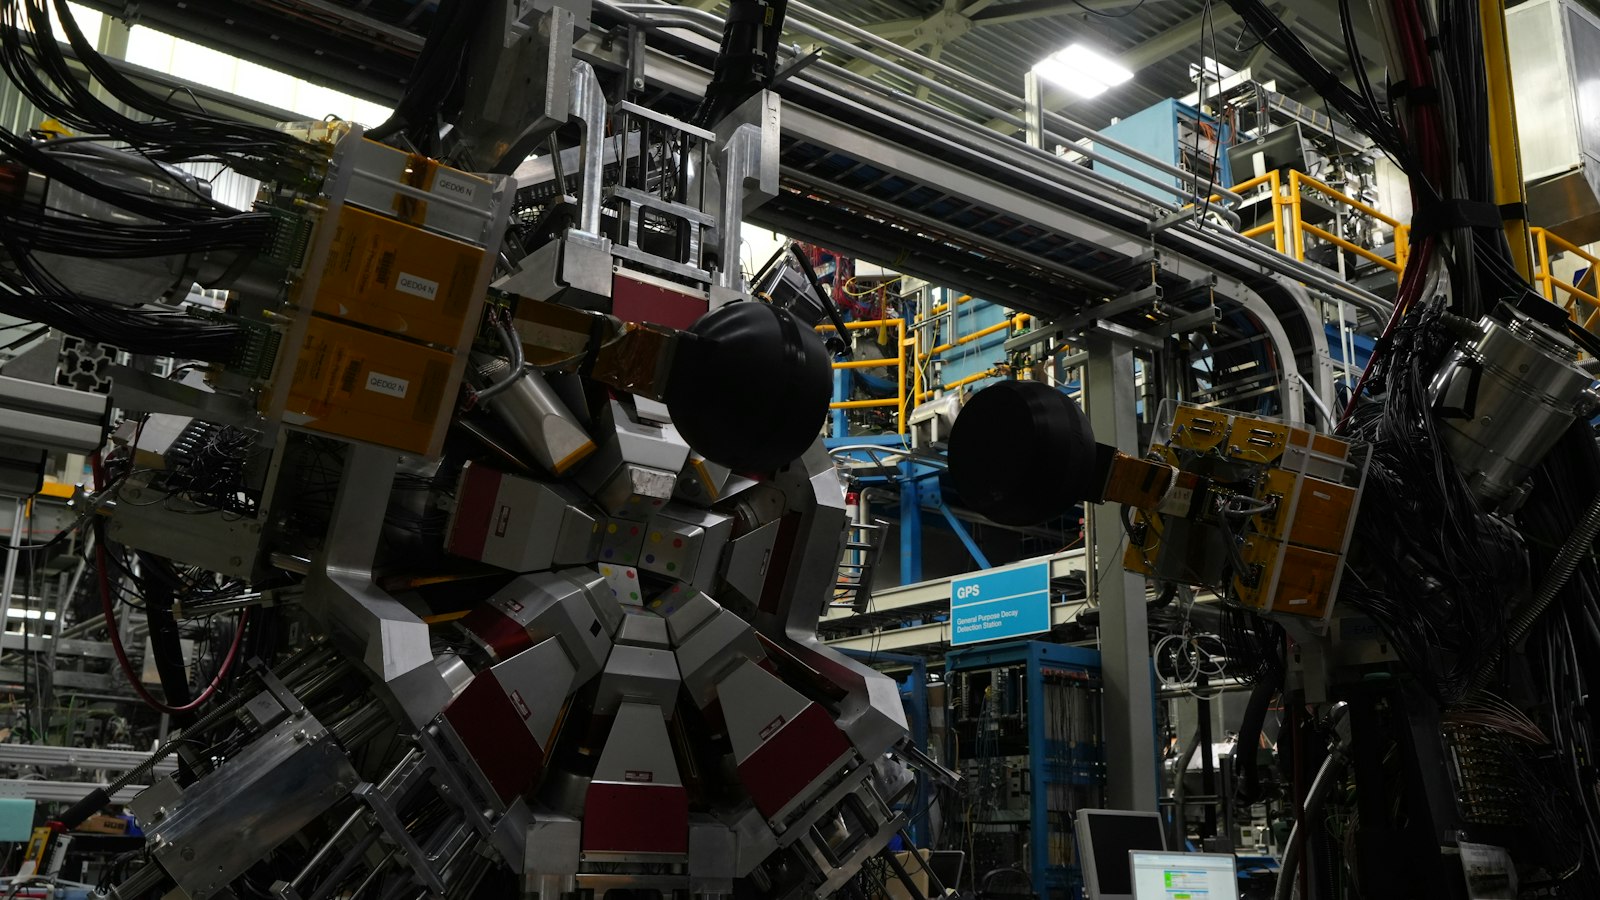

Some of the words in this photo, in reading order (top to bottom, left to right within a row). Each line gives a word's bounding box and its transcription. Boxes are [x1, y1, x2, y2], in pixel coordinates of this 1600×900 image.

[465, 188, 473, 196] N
[400, 278, 427, 292] QED04
[427, 286, 435, 294] N
[370, 377, 397, 391] QED02
[397, 385, 405, 393] N
[957, 584, 980, 599] GPS
[957, 616, 978, 625] General
[977, 613, 1000, 622] Purpose
[1000, 609, 1019, 618] Decay
[957, 624, 982, 633] Detection
[983, 620, 1002, 629] Station
